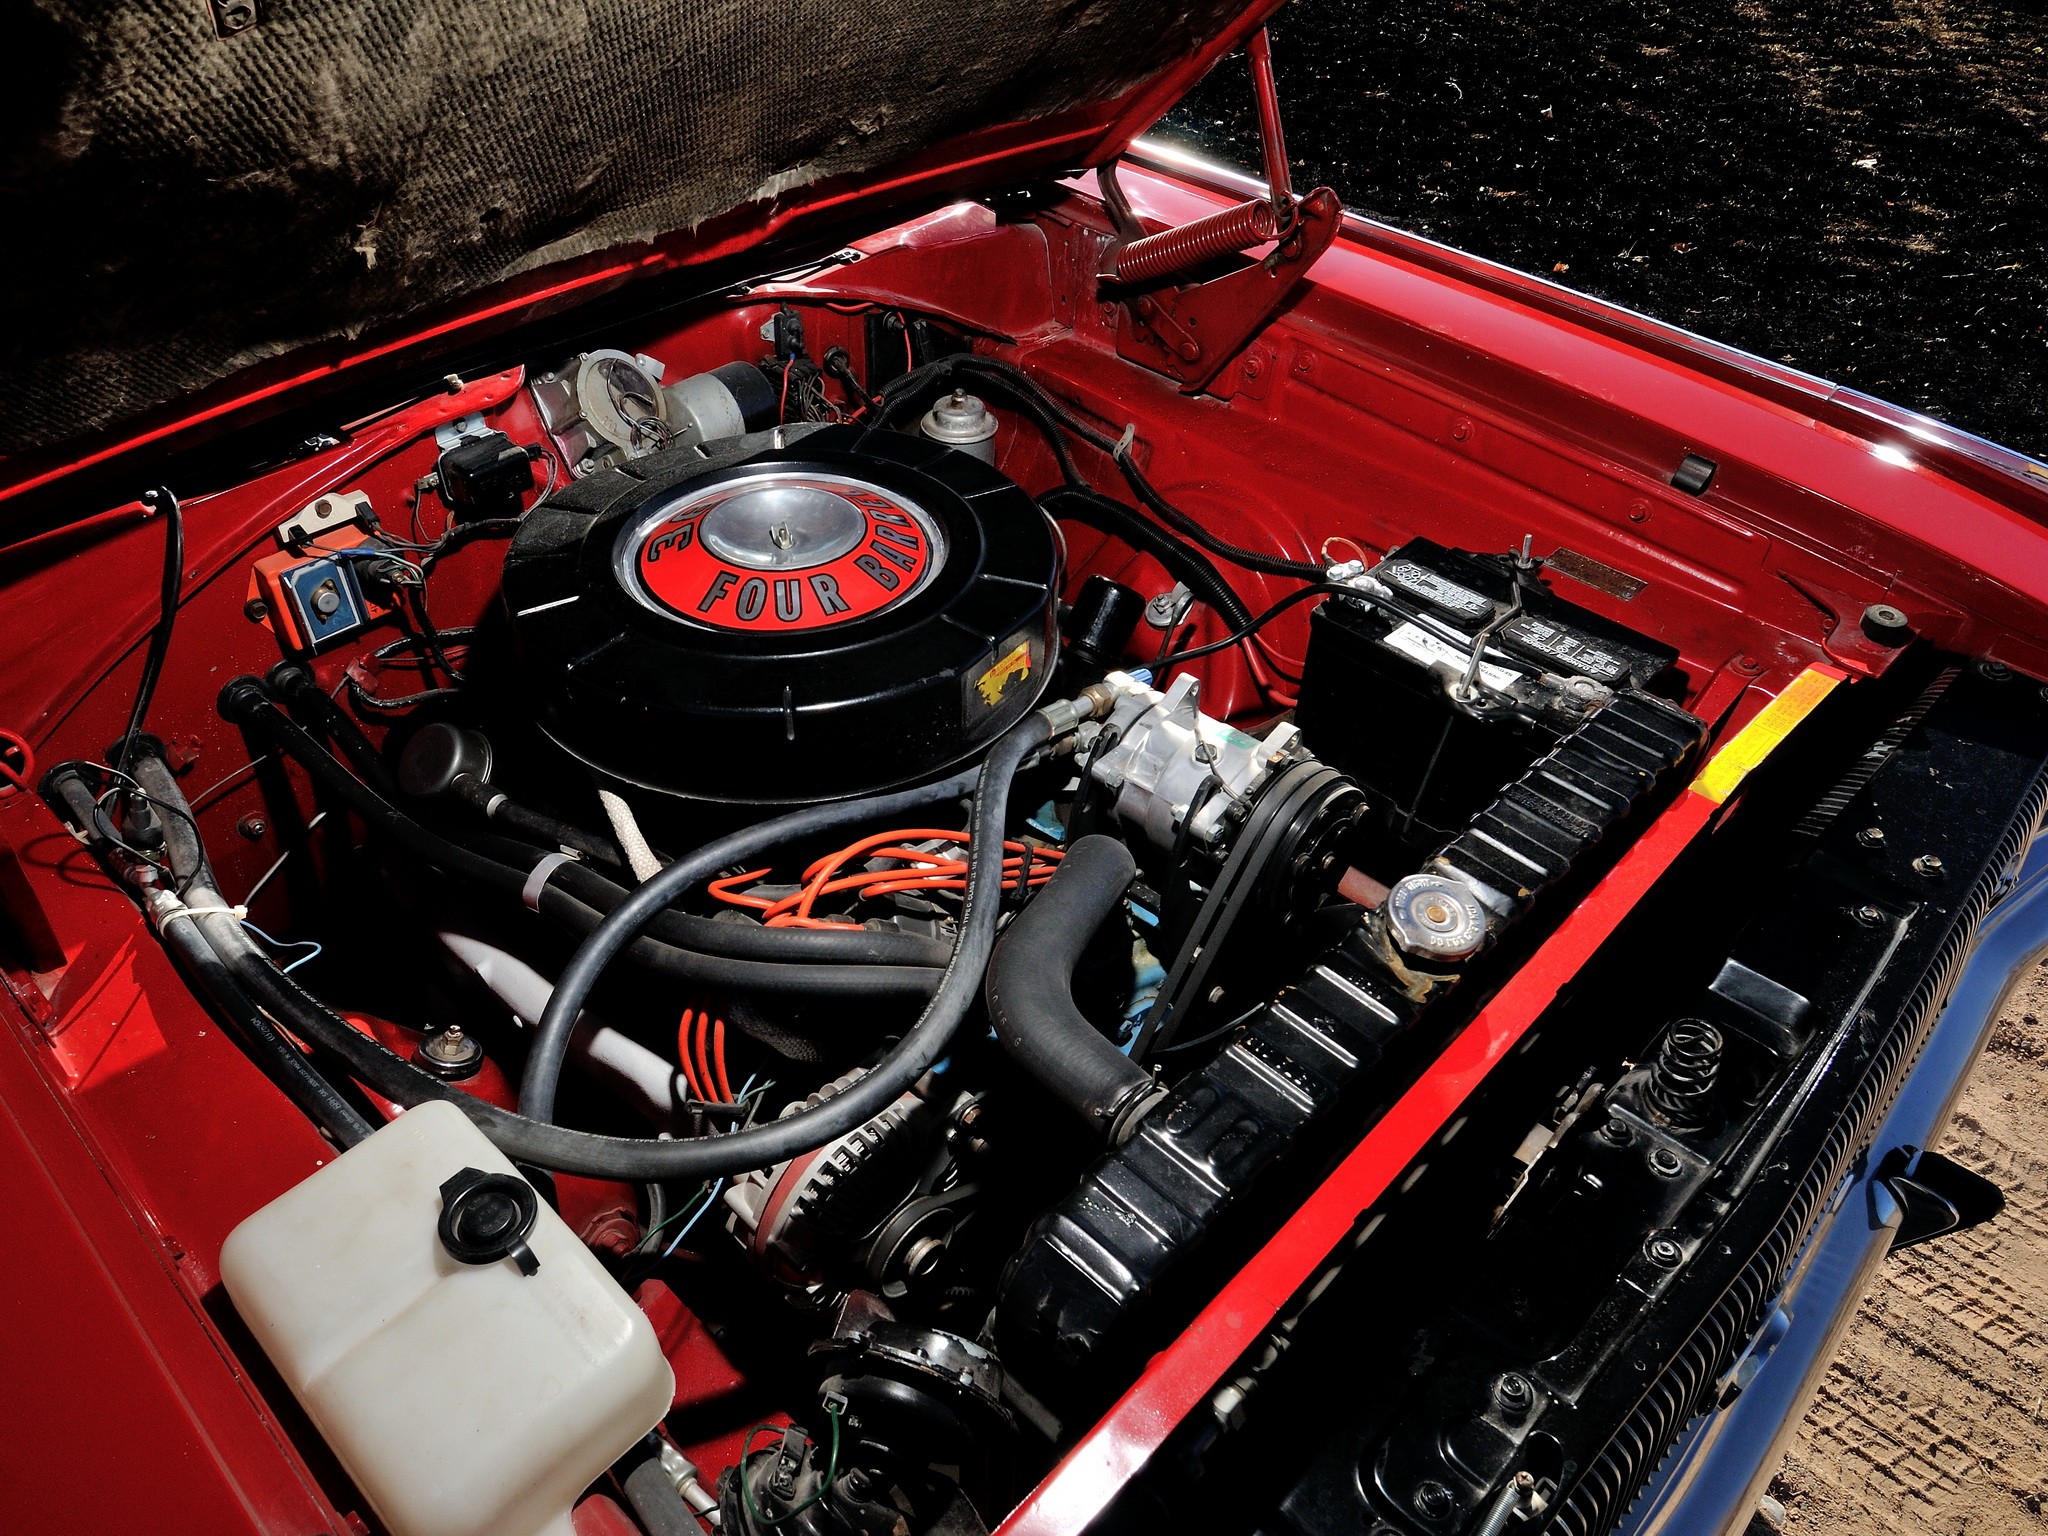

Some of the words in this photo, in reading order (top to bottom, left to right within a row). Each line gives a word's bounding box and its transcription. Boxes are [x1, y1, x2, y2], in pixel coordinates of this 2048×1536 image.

[697, 570, 852, 623] FOUR
[844, 488, 922, 592] BARREL
[1520, 635, 1551, 653] POISON
[1556, 652, 1589, 672] DANGER
[967, 881, 975, 900] CLASS
[963, 908, 972, 924] TYPE
[914, 1002, 934, 1029] GALAXY
